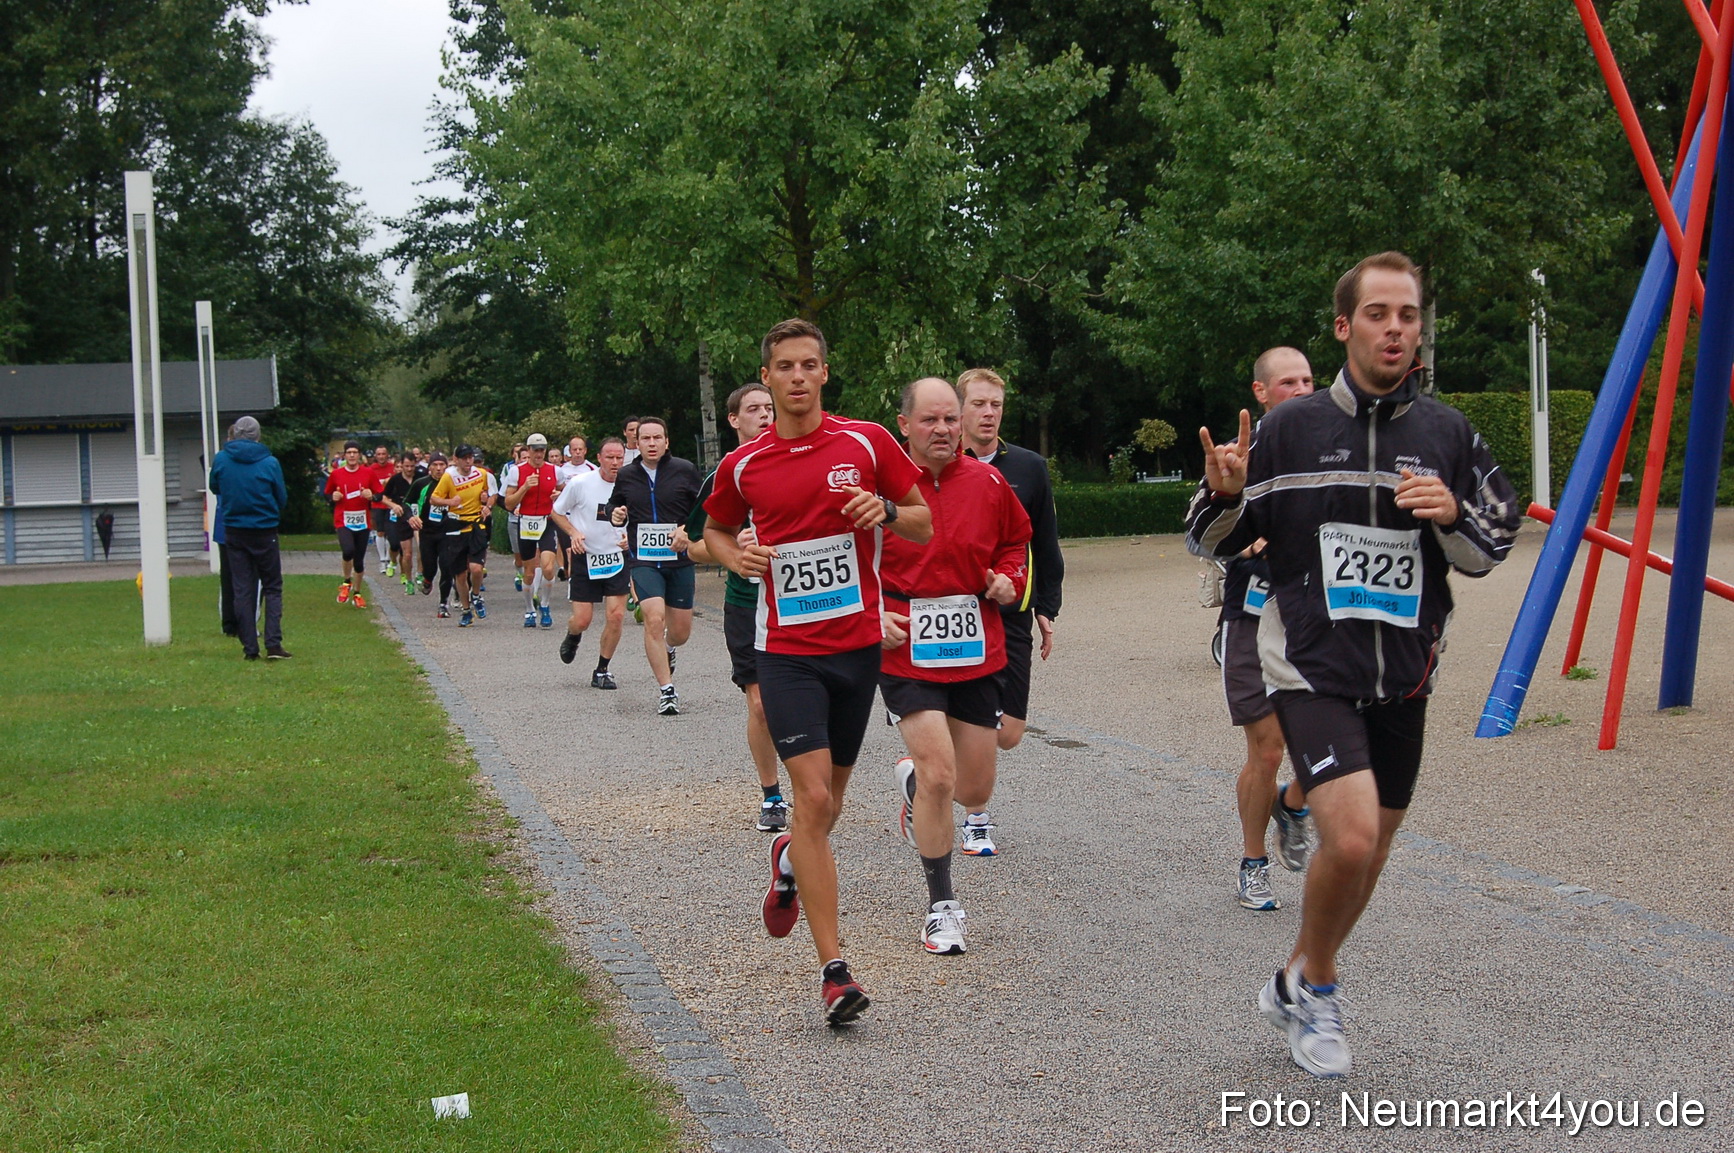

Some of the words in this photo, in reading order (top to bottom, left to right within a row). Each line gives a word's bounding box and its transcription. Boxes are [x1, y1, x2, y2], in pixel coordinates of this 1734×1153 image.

[528, 521, 539, 530] 60
[641, 533, 674, 547] 2505
[1323, 531, 1357, 545] PARTL
[1358, 536, 1411, 551] Neumarkt
[799, 544, 841, 558] Neumarkt
[590, 552, 620, 567] 2884
[781, 554, 851, 594] 2555
[1334, 546, 1415, 591] 2323
[797, 595, 842, 612] Thomas
[912, 604, 937, 612] PARTL
[1348, 590, 1399, 612] Johes
[919, 611, 978, 640] 2938
[937, 645, 963, 657] Josef
